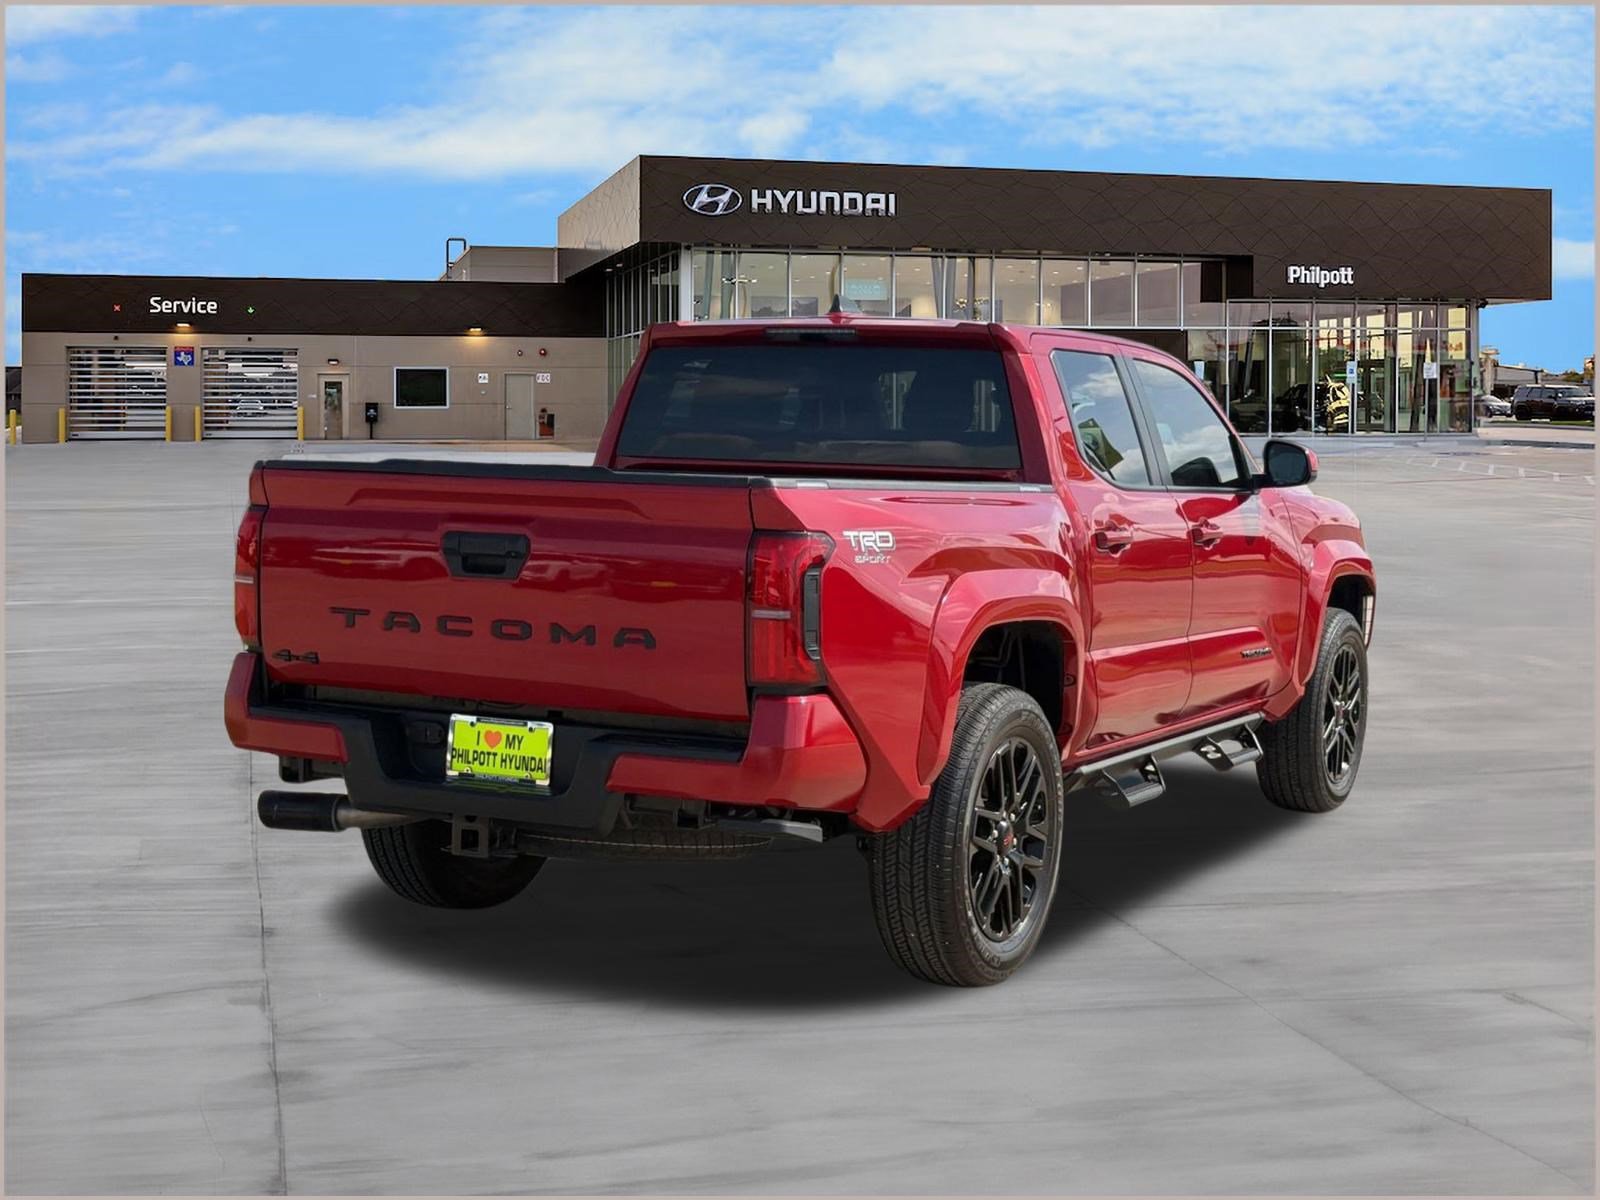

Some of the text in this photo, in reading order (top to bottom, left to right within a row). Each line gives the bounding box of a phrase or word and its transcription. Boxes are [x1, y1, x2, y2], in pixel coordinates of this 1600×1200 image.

[751, 188, 896, 217] HYUNDAI
[1287, 265, 1355, 288] Philpott
[149, 296, 219, 315] Service
[842, 530, 895, 553] TRD
[329, 605, 658, 650] TACOMA
[476, 731, 524, 750] I MY
[451, 747, 548, 774] PHILPOTT HYUNDAI
